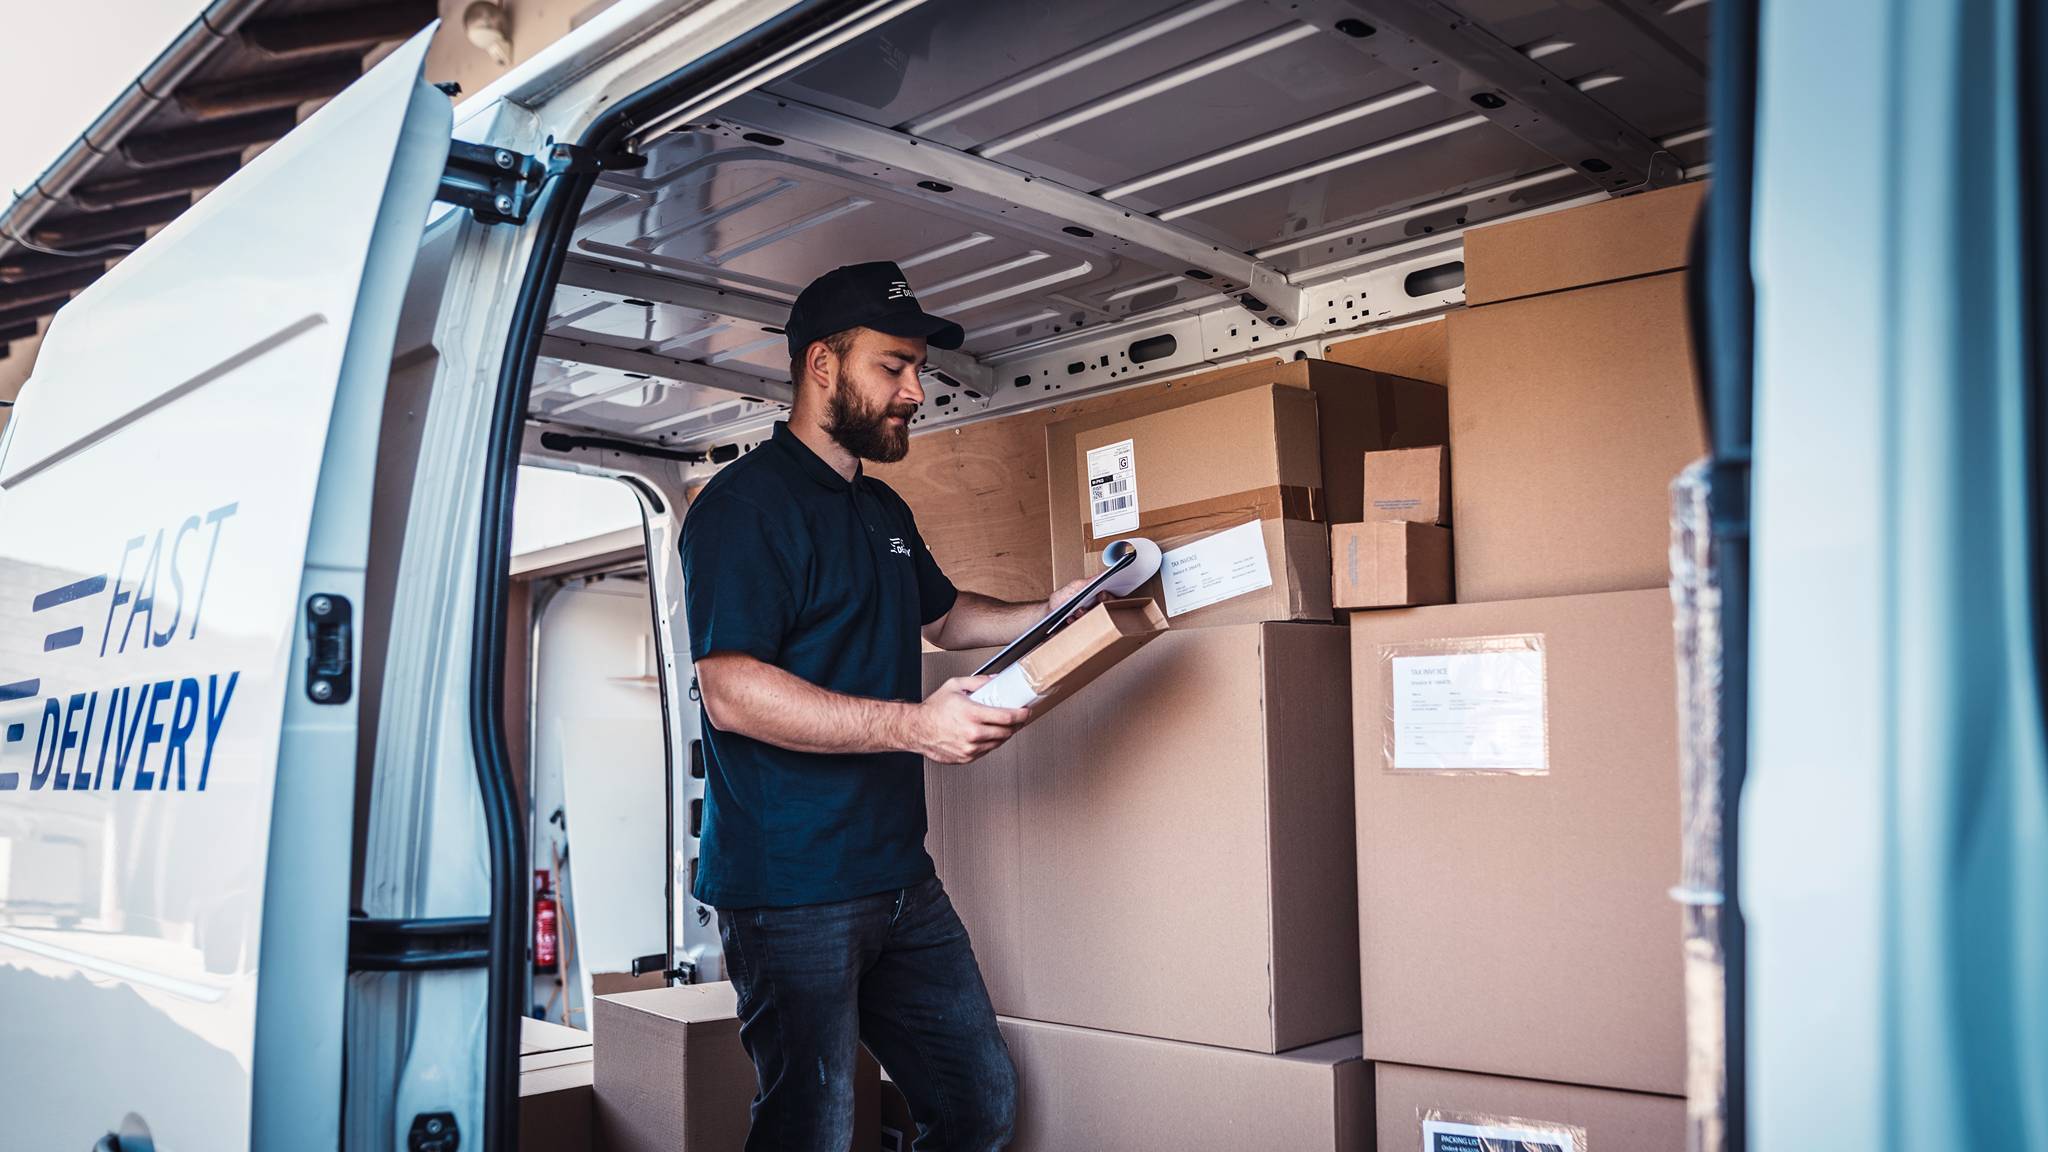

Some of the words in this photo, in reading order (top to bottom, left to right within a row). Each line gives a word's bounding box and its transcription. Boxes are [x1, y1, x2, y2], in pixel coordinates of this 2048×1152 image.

[1120, 458, 1127, 468] G
[100, 501, 239, 657] FAST
[30, 671, 240, 791] DELIVERY
[1441, 1135, 1467, 1145] PACKING
